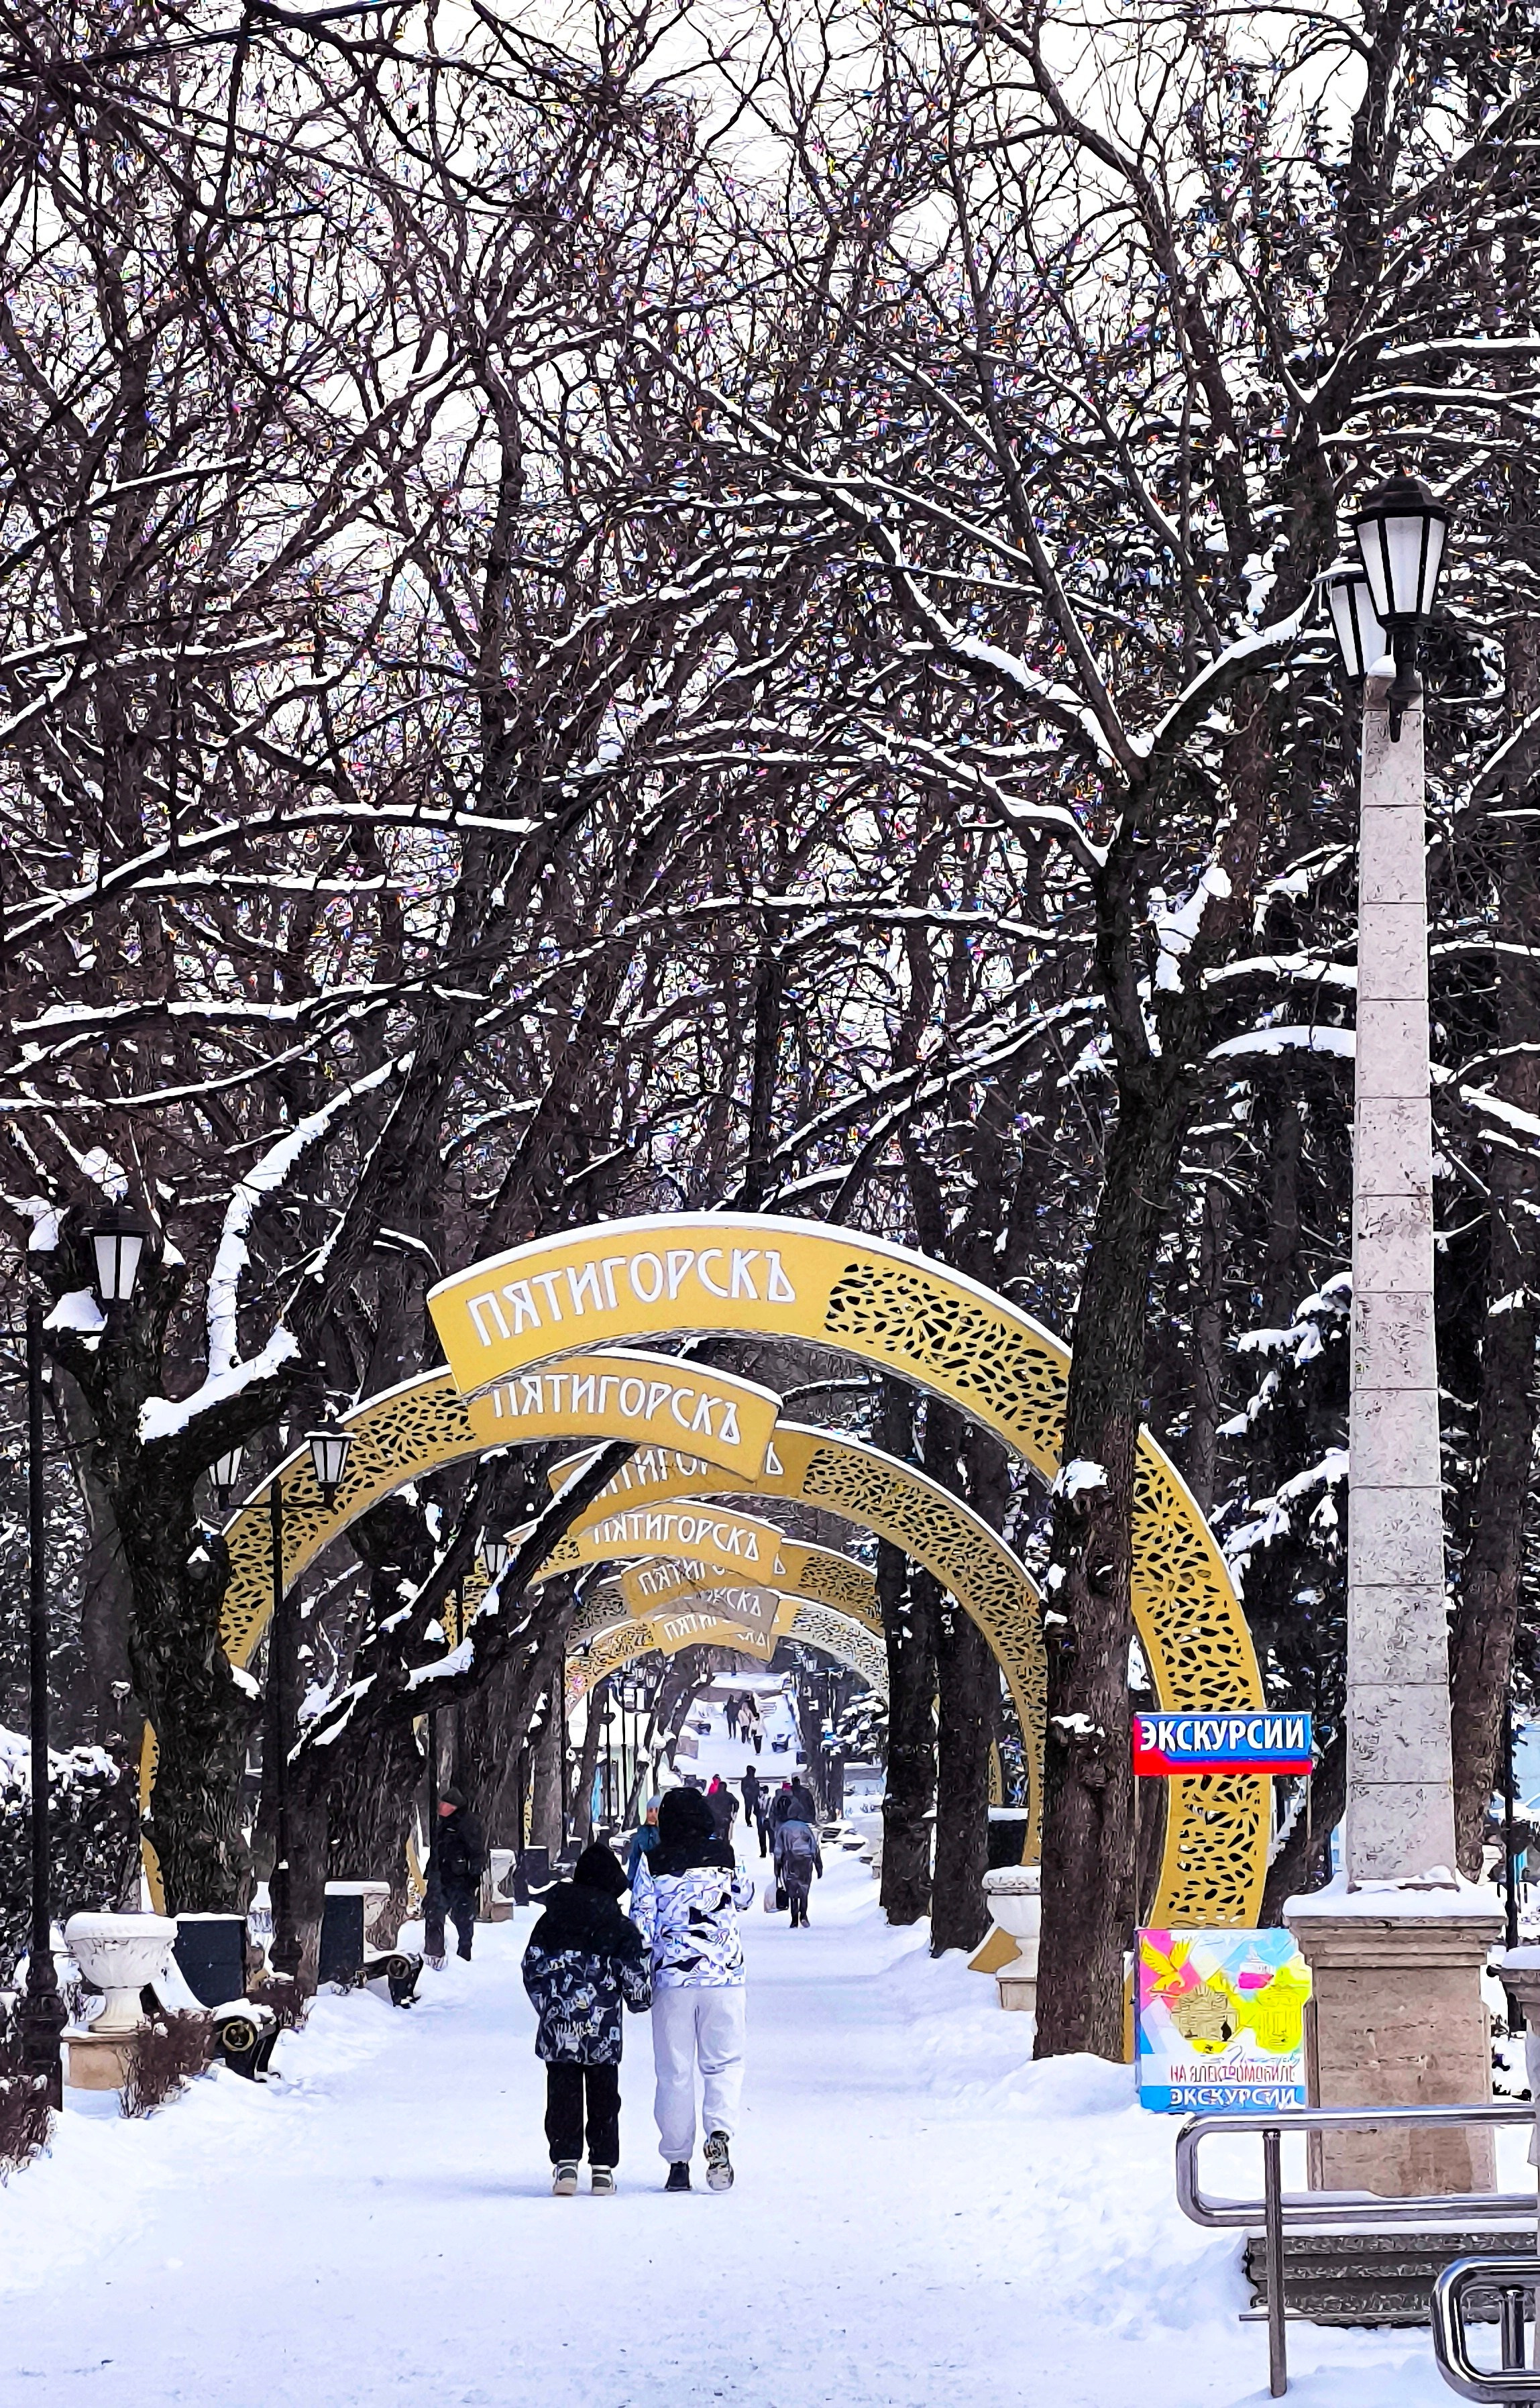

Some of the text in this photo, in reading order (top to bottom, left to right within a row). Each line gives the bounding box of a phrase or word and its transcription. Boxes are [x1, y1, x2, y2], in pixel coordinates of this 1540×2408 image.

[468, 1248, 795, 1346] ПЯТИГОРСКЪ
[493, 1374, 740, 1444] ПЯТИГОРСКЪ
[1140, 1717, 1304, 1752] ЭКСКУРСИИ
[1170, 2065, 1187, 2083] НА
[1170, 2087, 1297, 2106] ЭКСКУРСИИ
